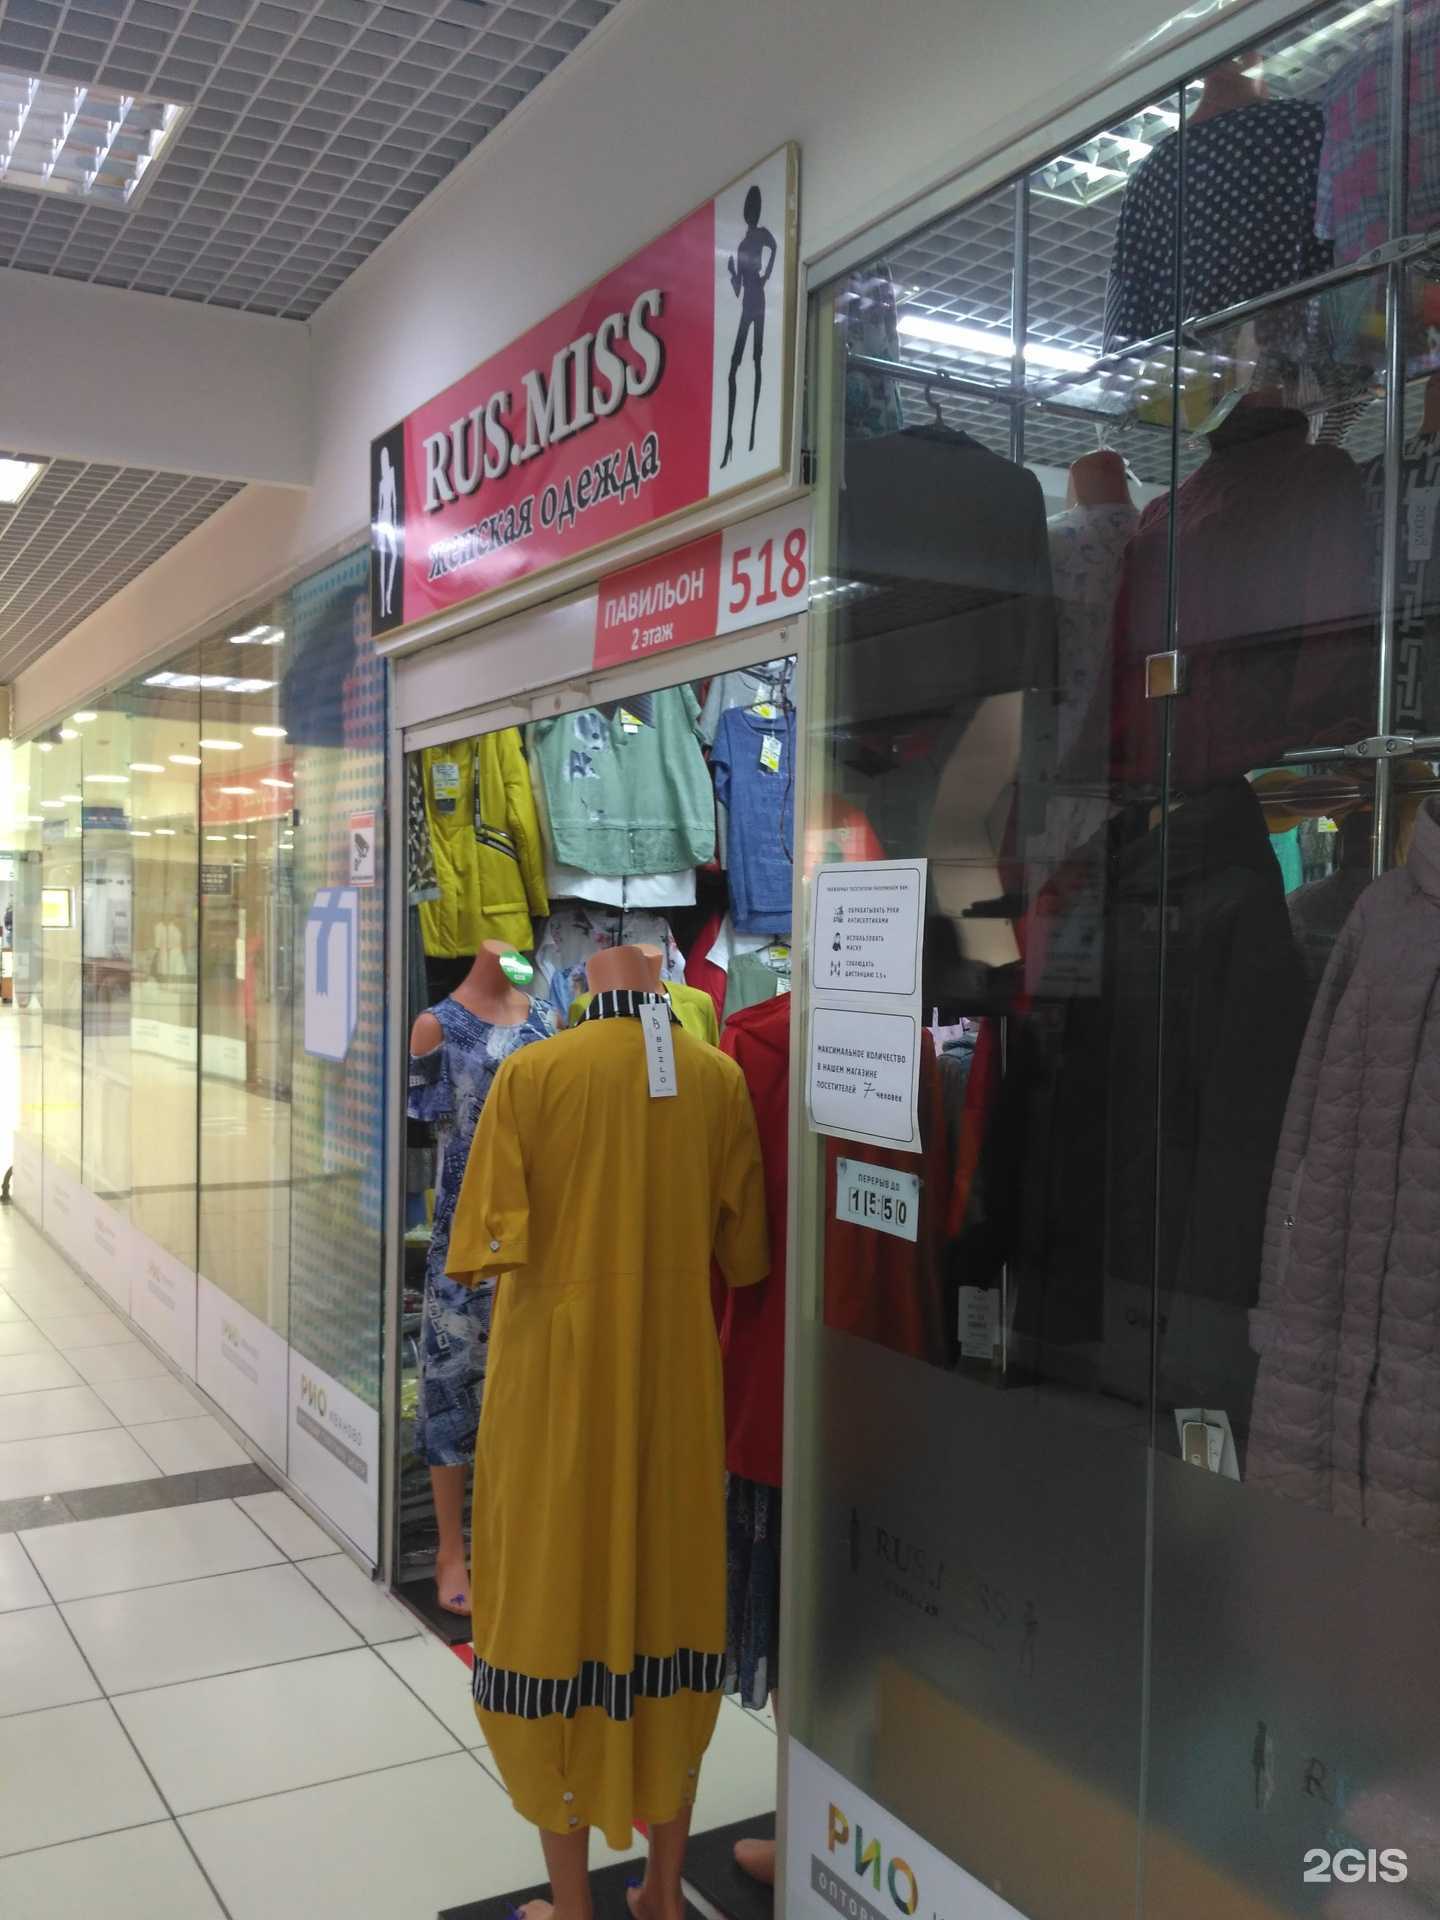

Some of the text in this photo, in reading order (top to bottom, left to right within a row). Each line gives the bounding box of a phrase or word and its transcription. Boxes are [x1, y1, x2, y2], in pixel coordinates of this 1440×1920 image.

[422, 288, 665, 513] RUS.MISS
[427, 431, 661, 582] женская одежда
[728, 527, 807, 615] 518
[604, 567, 705, 630] ПАВИЛЬОН
[631, 621, 674, 650] 2 этаж
[817, 1045, 906, 1063] МАКСИМАЛЬНОЕ КОЛИЧЕСТВО
[817, 1062, 878, 1079] В НАШЕМ МАГАЗИНЕ
[816, 1080, 856, 1094] ПОСЕТИТЕЛЕЙ
[863, 1082, 876, 1098] 7
[858, 1173, 889, 1189] ПЕРЕРЫВ
[828, 1802, 918, 1916] РИО
